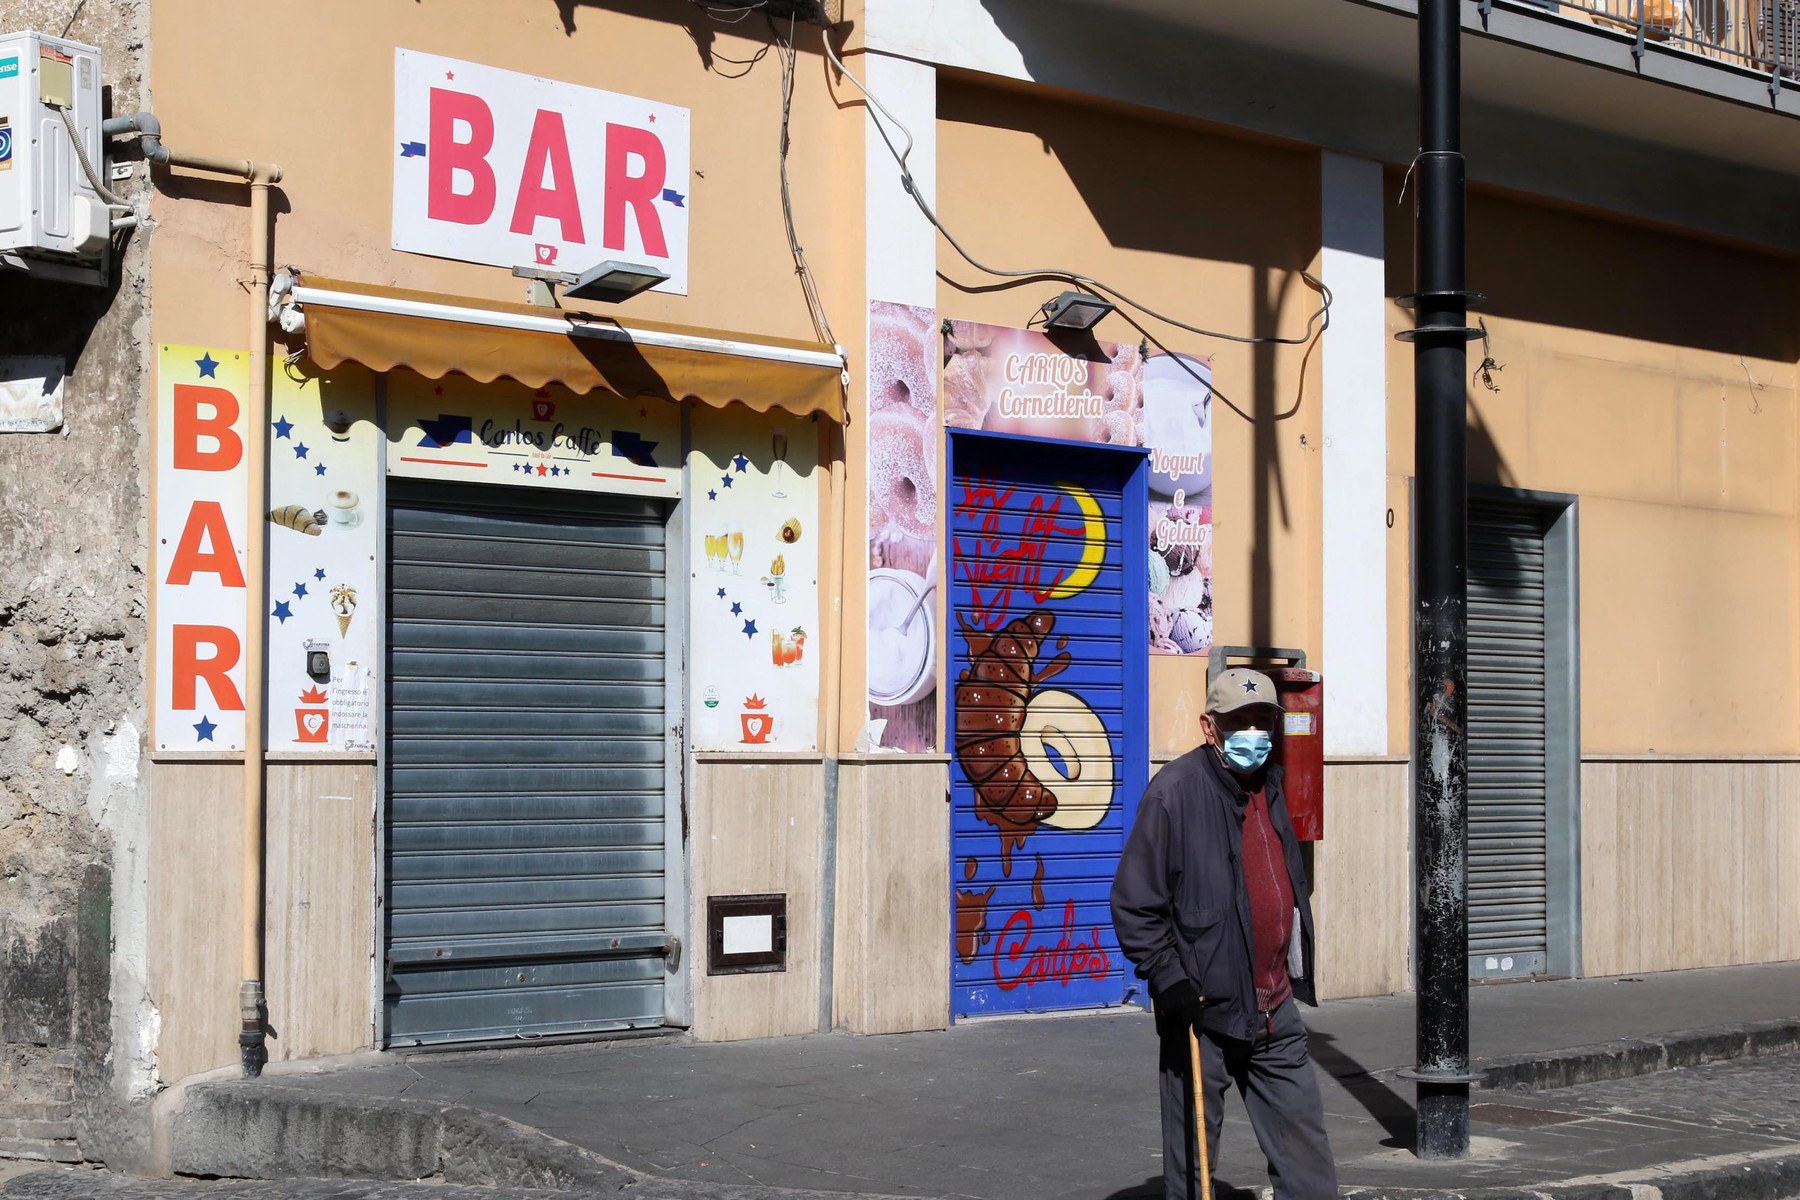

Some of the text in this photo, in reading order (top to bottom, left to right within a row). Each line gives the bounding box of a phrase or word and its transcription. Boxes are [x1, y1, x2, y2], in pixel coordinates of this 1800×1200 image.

[0, 63, 17, 73] nse
[428, 86, 669, 258] BAR
[1005, 354, 1088, 390] CARLOS
[999, 387, 1103, 417] Cornetteria
[480, 418, 602, 458] Carlos Caffè
[1149, 447, 1204, 480] Yogurt
[1173, 489, 1185, 508] e
[165, 383, 247, 711] BAR
[1156, 519, 1206, 551] Gelato
[332, 699, 369, 707] obbligatorio
[332, 710, 368, 718] indossare la
[993, 898, 1109, 991] Carlos
